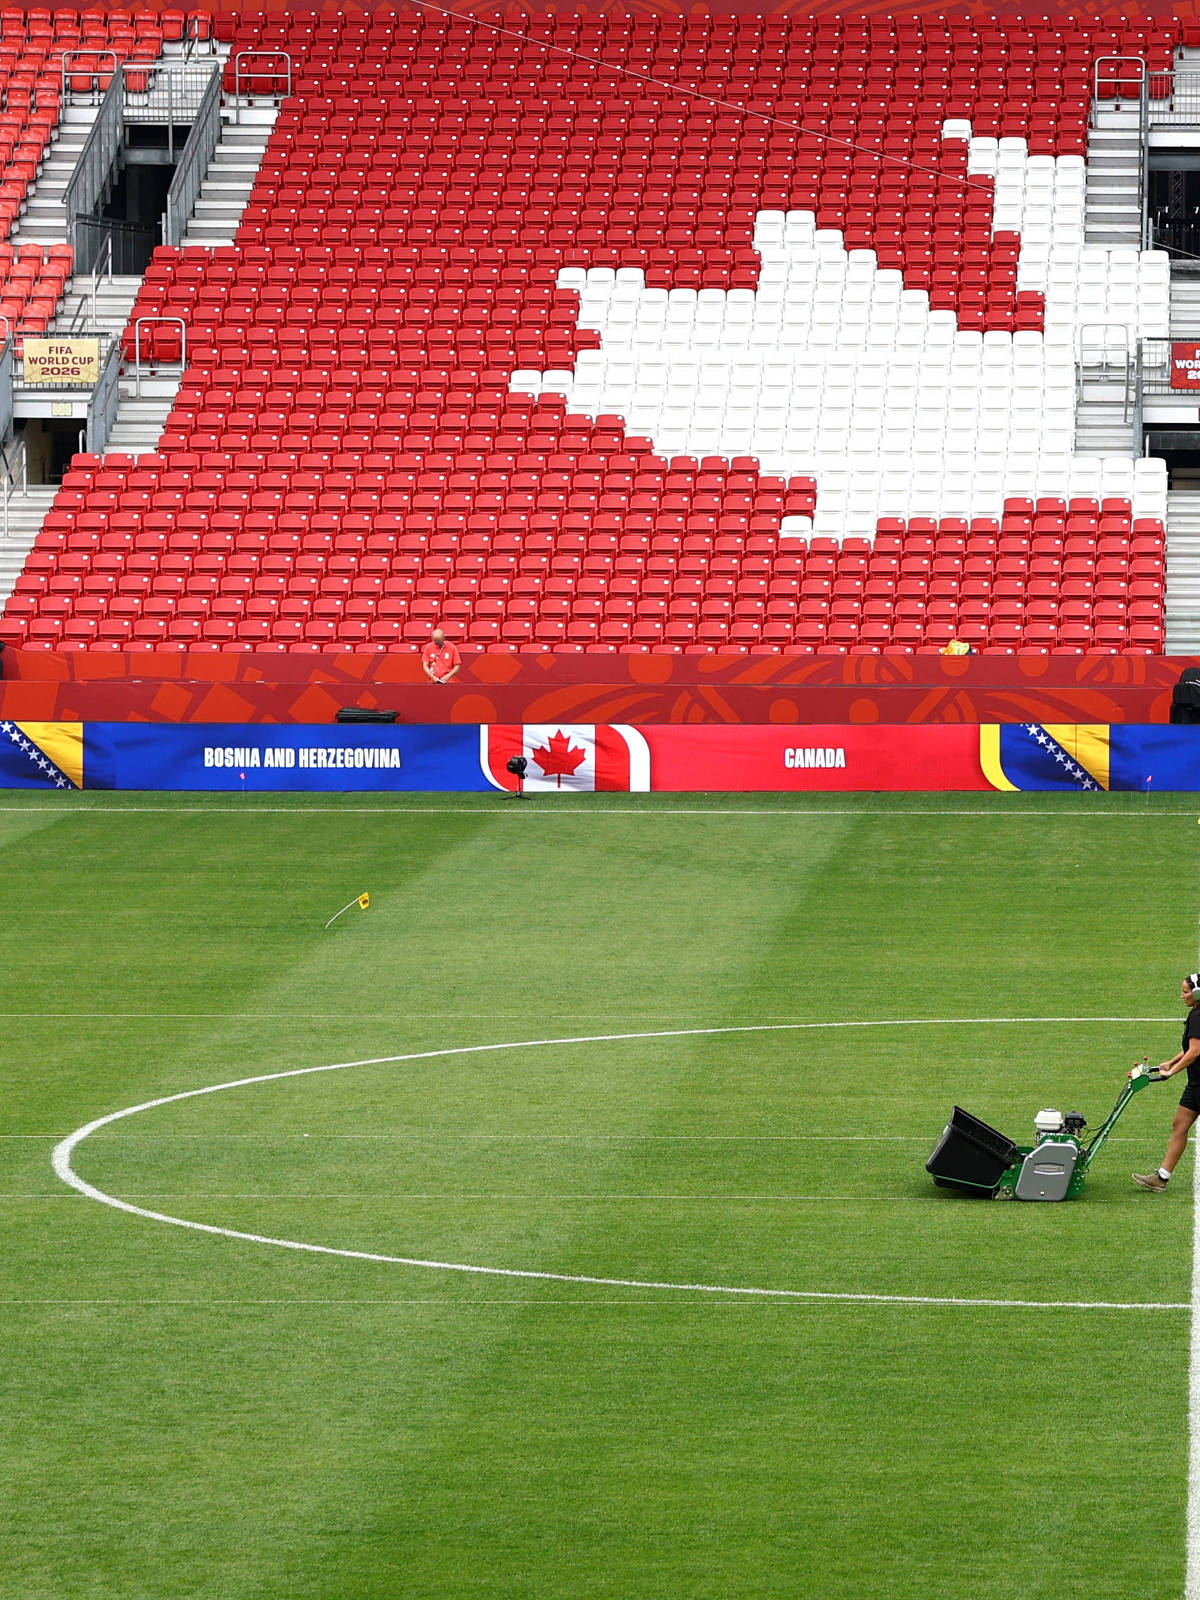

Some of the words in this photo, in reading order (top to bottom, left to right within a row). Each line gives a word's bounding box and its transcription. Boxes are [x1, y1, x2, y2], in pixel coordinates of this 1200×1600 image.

[48, 346, 73, 355] FIFA
[28, 356, 70, 365] WORLD
[71, 356, 94, 365] CUP
[41, 366, 81, 376] 2026
[204, 747, 261, 768] BOSNIA
[263, 748, 296, 768] AND
[299, 748, 401, 769] HERZEGOVINA
[784, 747, 847, 769] CANADA
